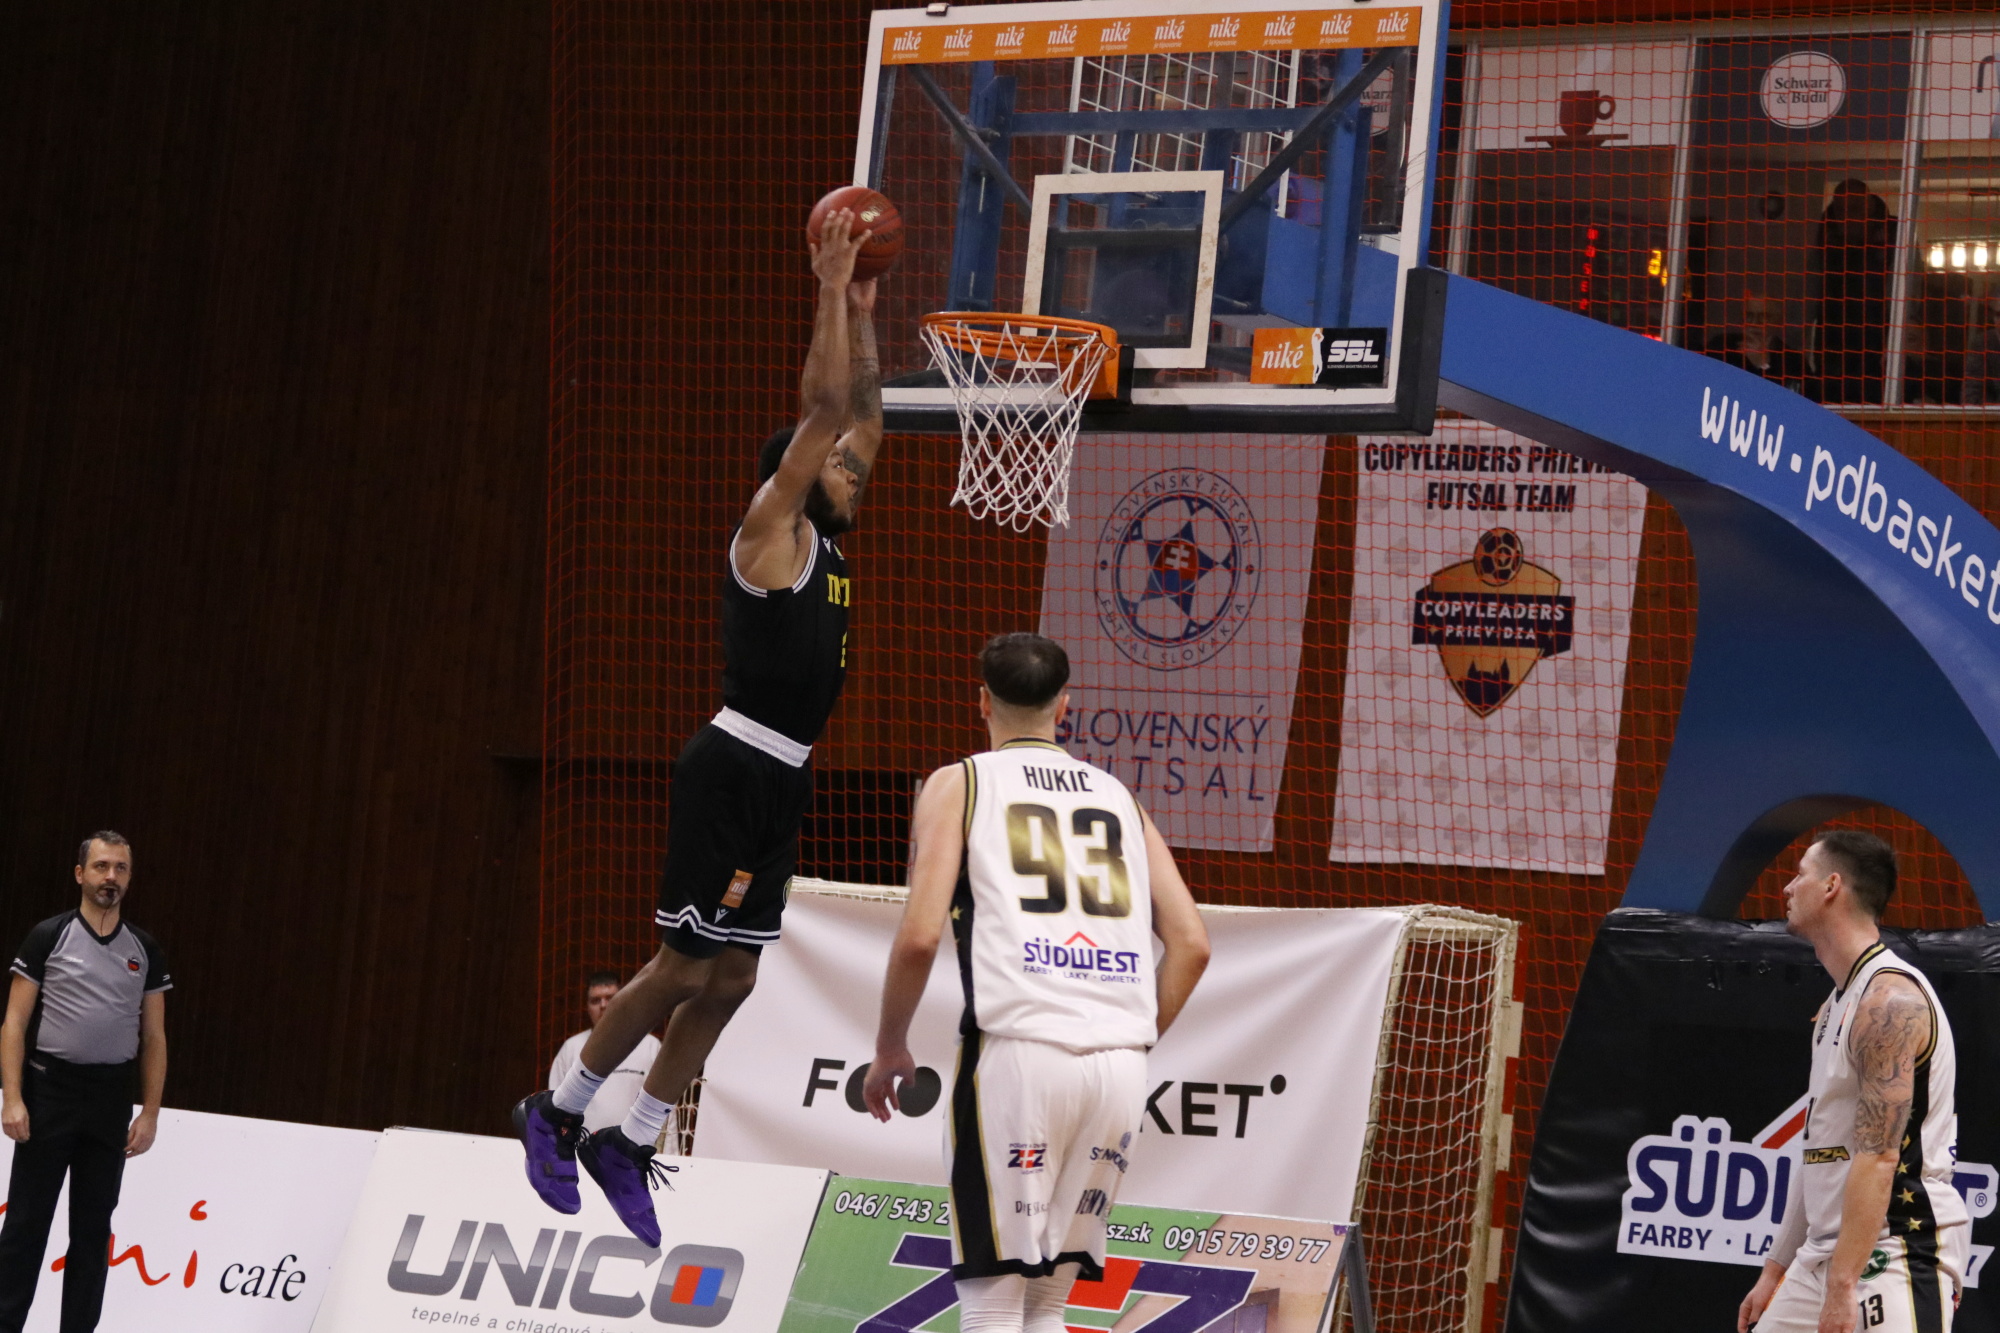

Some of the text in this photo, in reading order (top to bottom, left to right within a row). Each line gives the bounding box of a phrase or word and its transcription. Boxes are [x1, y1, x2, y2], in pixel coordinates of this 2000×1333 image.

[1047, 23, 1078, 45] niké
[1101, 21, 1131, 42] niké
[1155, 19, 1185, 40] niké
[1209, 16, 1240, 38] niké
[1264, 15, 1296, 36] niké
[1320, 13, 1352, 35] niké
[1377, 11, 1409, 34] niké
[893, 30, 922, 51] niké
[944, 28, 973, 49] niké
[996, 25, 1025, 47] niké
[1774, 77, 1832, 90] Schwarz
[1261, 340, 1380, 369] niké SBL
[1364, 443, 1522, 474] COPYLEADERS
[1427, 482, 1577, 513] FUTSAL TEAM
[1421, 602, 1565, 621] COPYLEADERS
[1445, 625, 1537, 641] PRIEVIDZA
[1055, 704, 1270, 754] SLOVENSKÝ
[1023, 765, 1093, 793] HUKIĆ
[1086, 754, 1265, 801] TSAL
[1005, 802, 1132, 919] 93
[1024, 936, 1140, 974] SÜDWEST
[1063, 971, 1089, 980] LAKY
[834, 1191, 890, 1219] 046/
[888, 1196, 933, 1223] 543
[1106, 1221, 1331, 1263] sz.sk 0915 79 39 77
[1627, 1222, 1774, 1256] FARBY LA
[219, 1254, 306, 1302] cafe
[387, 1214, 745, 1329] UNICO
[411, 1306, 480, 1325] tepelné
[487, 1317, 498, 1329] a
[1860, 1293, 1885, 1331] 13
